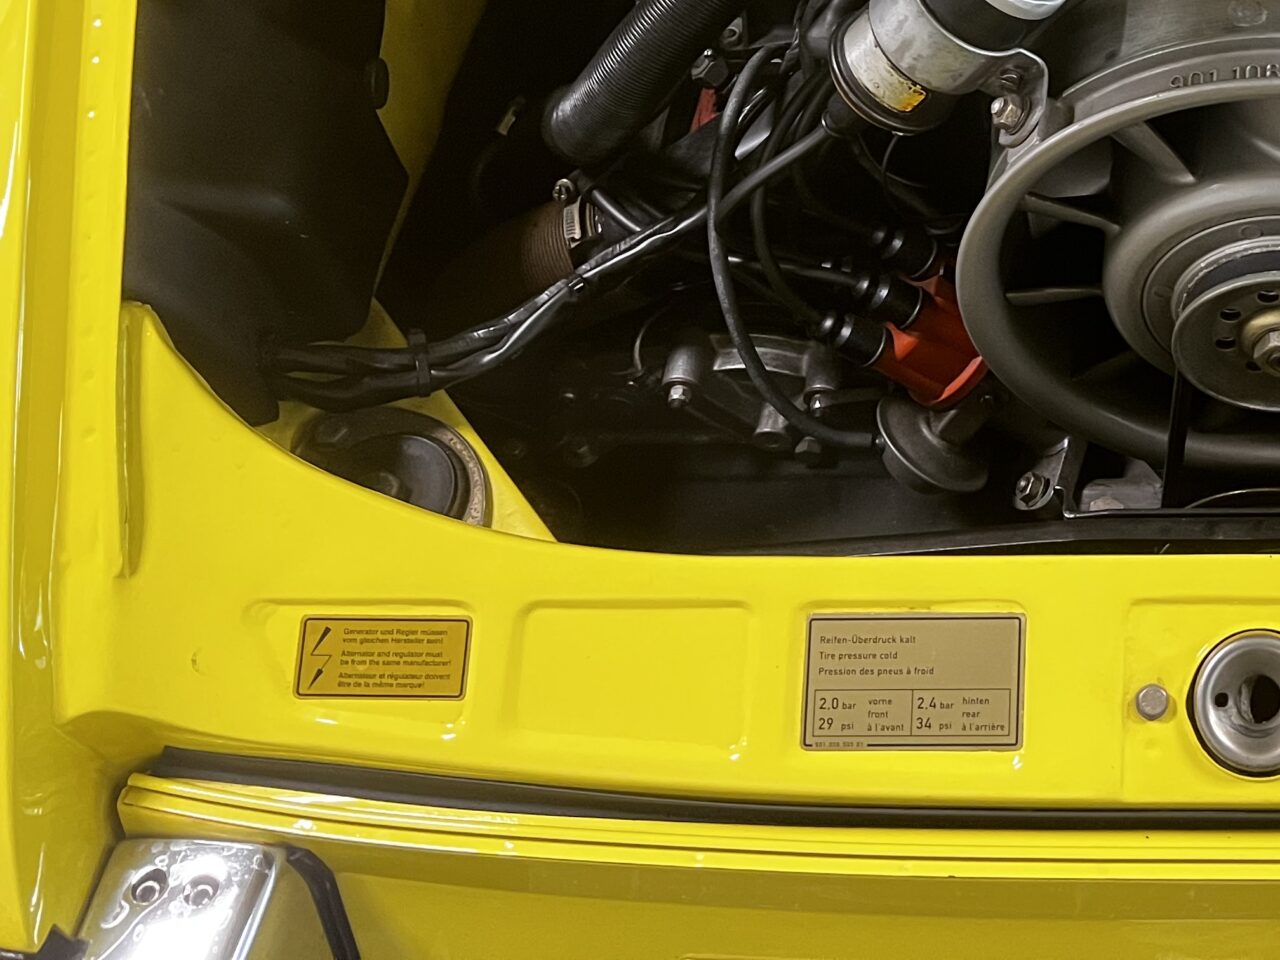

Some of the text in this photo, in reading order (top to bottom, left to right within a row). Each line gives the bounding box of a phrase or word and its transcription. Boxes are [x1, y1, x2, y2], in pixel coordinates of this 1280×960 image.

[820, 634, 916, 644] Reifen-Überdruck kalt
[819, 651, 898, 662] Tire pressure cold
[818, 667, 857, 676] Pression
[859, 667, 875, 676] des
[877, 668, 904, 678] pneus
[905, 667, 912, 676] à
[962, 696, 990, 705] hinten
[842, 702, 857, 710] bar
[939, 701, 954, 710] bar
[867, 710, 889, 719] front
[961, 711, 981, 719] rear
[818, 717, 855, 732] 29 psi
[867, 723, 873, 732] à
[916, 717, 953, 732] 34 psi
[961, 722, 967, 732] à
